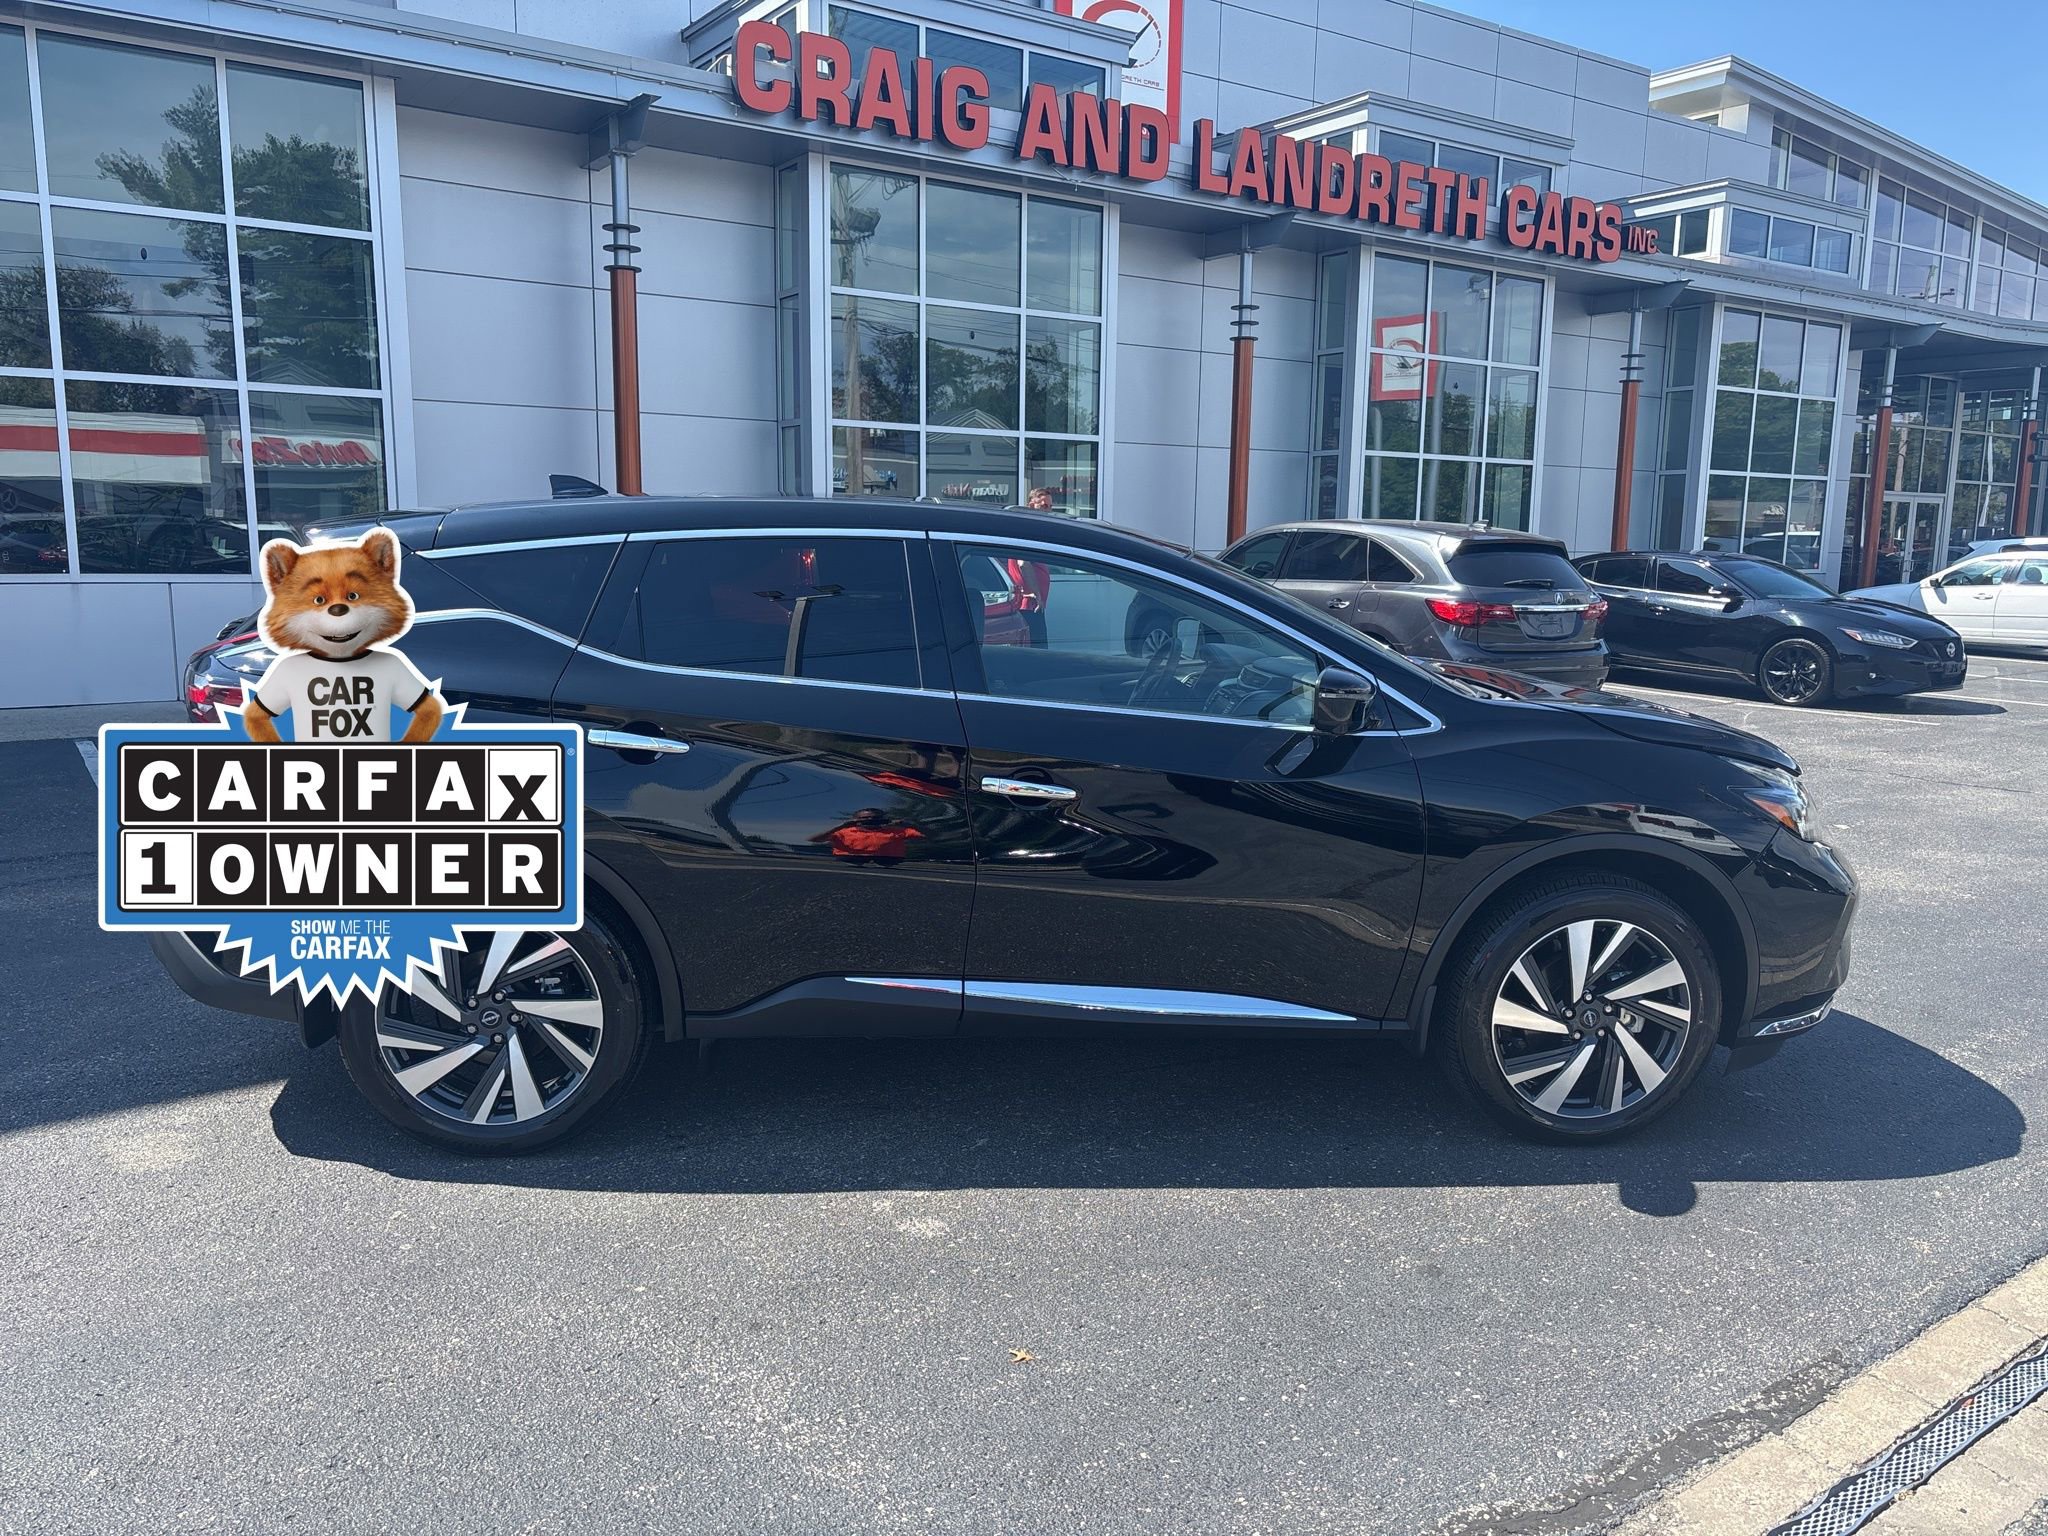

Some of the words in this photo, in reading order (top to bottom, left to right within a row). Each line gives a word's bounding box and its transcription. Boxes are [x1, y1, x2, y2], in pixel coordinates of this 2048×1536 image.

[732, 20, 990, 150] CRAIG
[1018, 82, 1170, 182] AND
[1195, 118, 1489, 241] LANDRETH
[1503, 184, 1623, 263] CARS
[1627, 224, 1659, 255] INC
